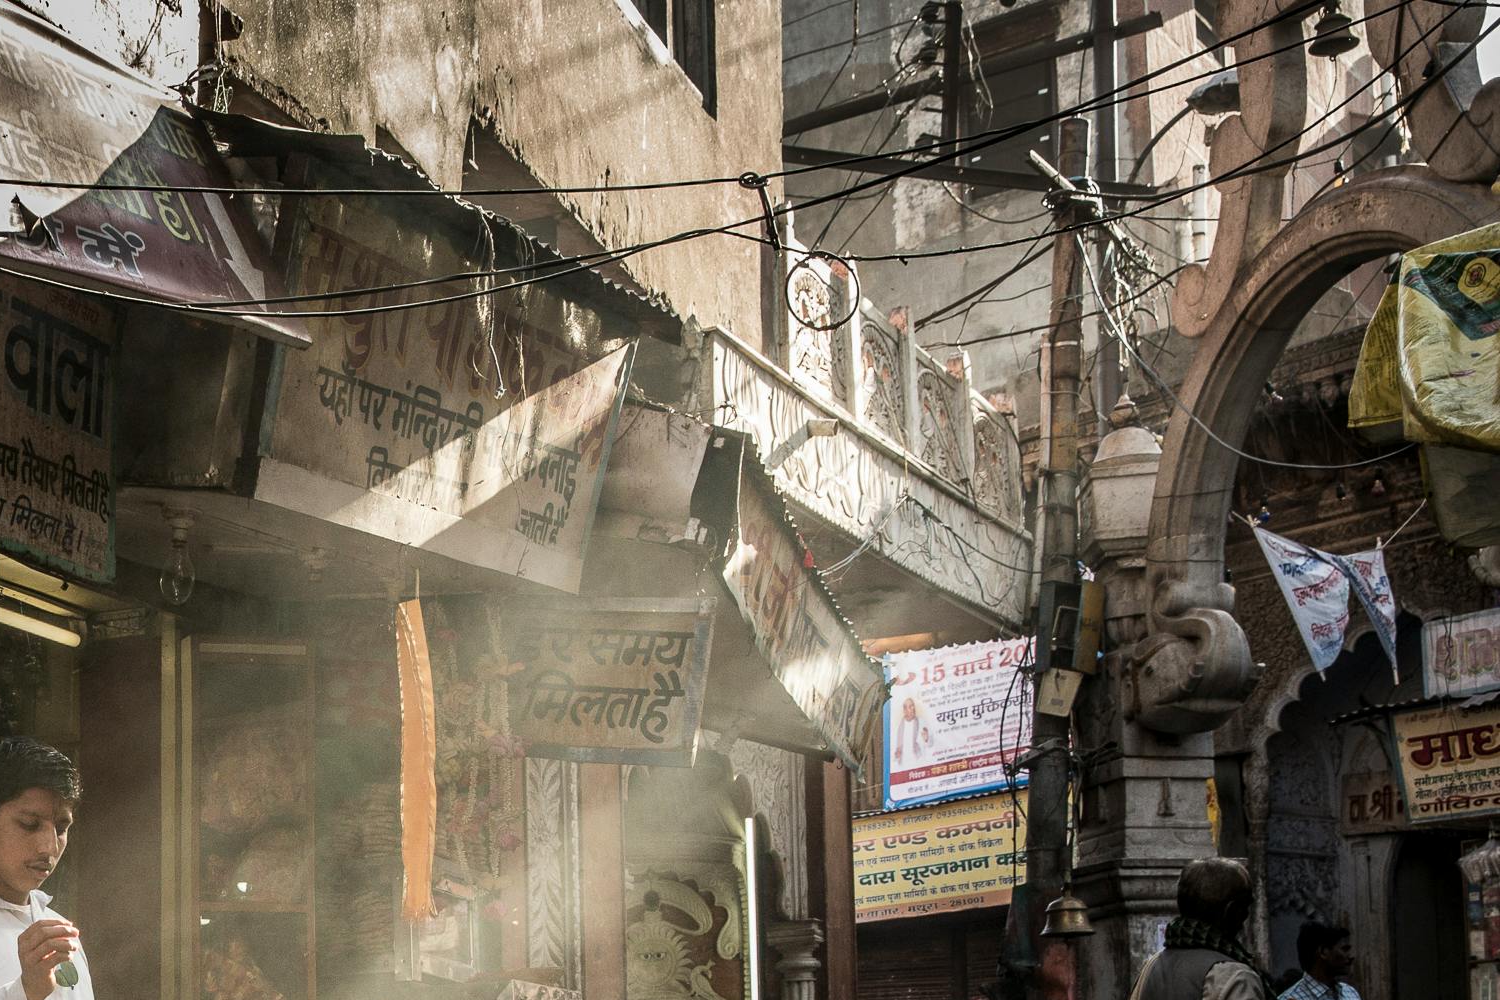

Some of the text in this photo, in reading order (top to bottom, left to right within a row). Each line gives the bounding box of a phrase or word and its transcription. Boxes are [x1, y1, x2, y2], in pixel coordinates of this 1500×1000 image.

[75, 222, 146, 280] में
[318, 361, 356, 426] यहाँ
[358, 381, 391, 431] पर
[21, 438, 59, 496] तैयार
[62, 454, 101, 513] मिलती
[10, 494, 62, 542] मिलता
[588, 628, 695, 668] समय
[919, 664, 946, 688] 15
[952, 651, 994, 677] मार्च
[522, 669, 685, 744] मिलता है
[936, 707, 969, 725] यमुना
[1370, 784, 1394, 821] श्री
[882, 830, 929, 849] एण्ड
[935, 811, 1021, 841] कम्पनी
[858, 870, 896, 886] दास
[900, 856, 990, 886] सूरजभान
[902, 852, 917, 863] पूजा
[887, 893, 901, 903] पूजा
[972, 879, 997, 891] फुटकर
[907, 903, 938, 914] मथुरा
[949, 896, 985, 907] 281001
